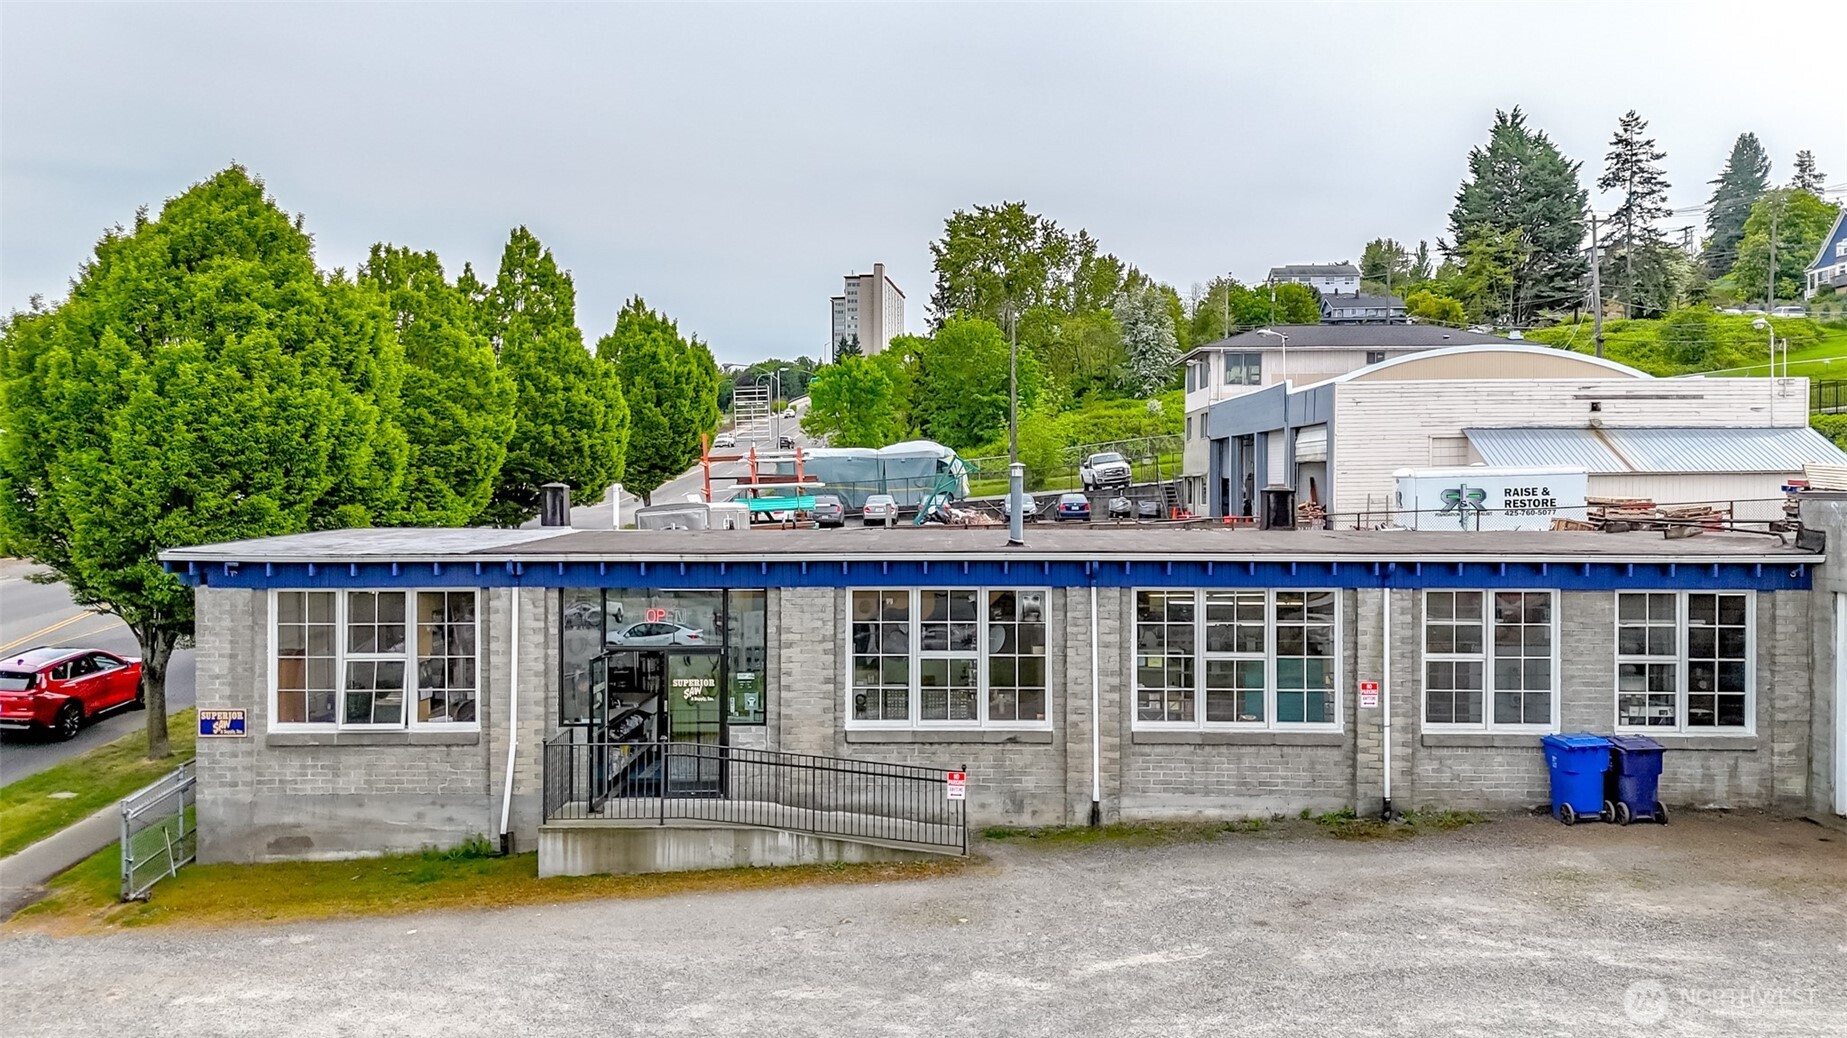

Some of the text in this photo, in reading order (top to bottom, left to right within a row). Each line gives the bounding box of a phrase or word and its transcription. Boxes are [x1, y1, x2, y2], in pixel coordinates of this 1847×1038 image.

[1504, 486, 1551, 497] RAISE &
[1504, 498, 1557, 508] RESTORE
[1504, 509, 1557, 517] 425-760-5077
[672, 678, 716, 687] SUPERIOR
[201, 711, 244, 720] SUPERIOR
